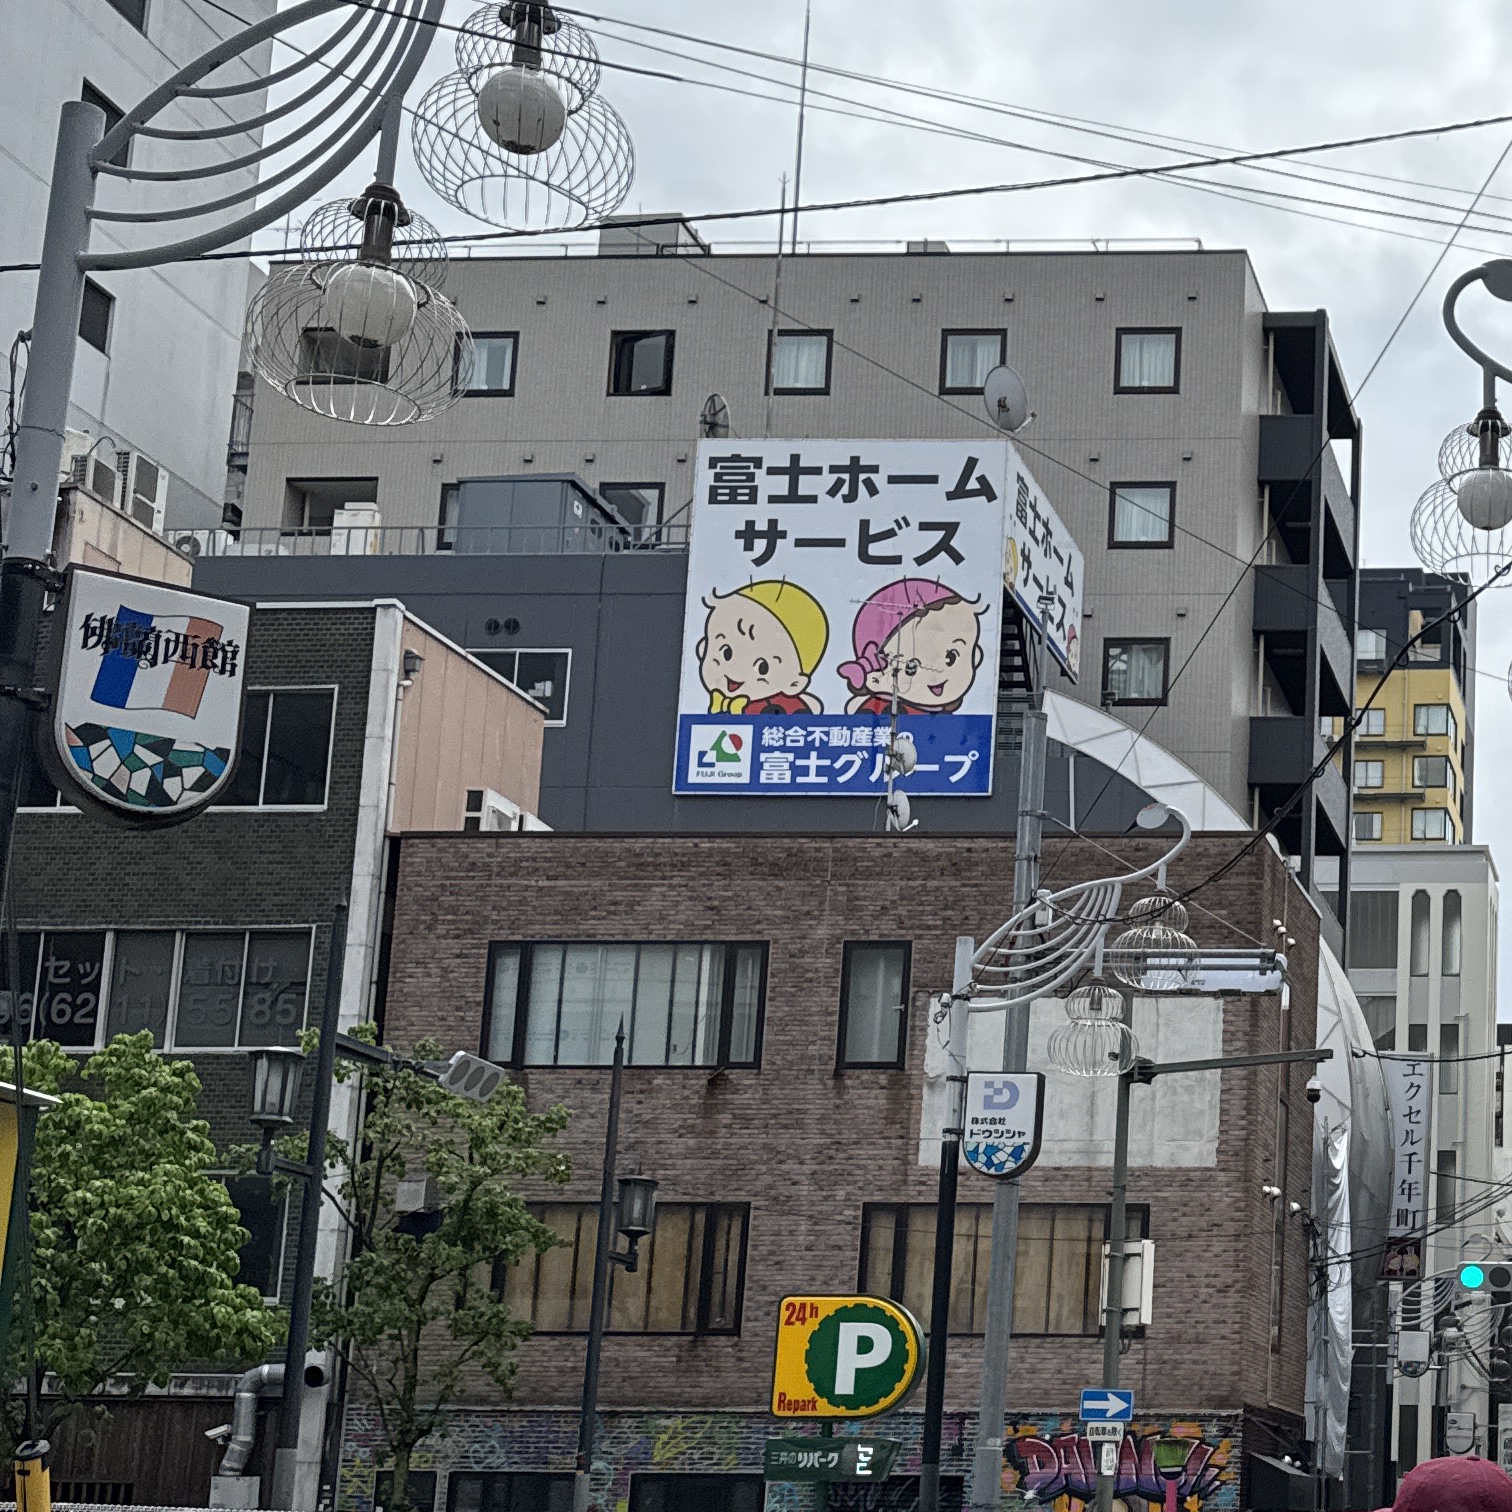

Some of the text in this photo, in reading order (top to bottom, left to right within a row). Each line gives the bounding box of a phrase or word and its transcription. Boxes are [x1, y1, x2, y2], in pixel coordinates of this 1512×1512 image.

[707, 453, 998, 506] 富士ホーム
[734, 515, 966, 568] サービス
[1016, 471, 1075, 597] 富士ホーム
[758, 748, 981, 785] 富士グループ
[969, 1128, 1026, 1139] ドウシシャ
[970, 1116, 1007, 1126] 株式会社
[1396, 1062, 1425, 1232] エクセル千年町
[834, 1322, 893, 1395] P
[777, 1391, 818, 1415] Repark
[770, 1450, 839, 1469] 三井のリパーク
